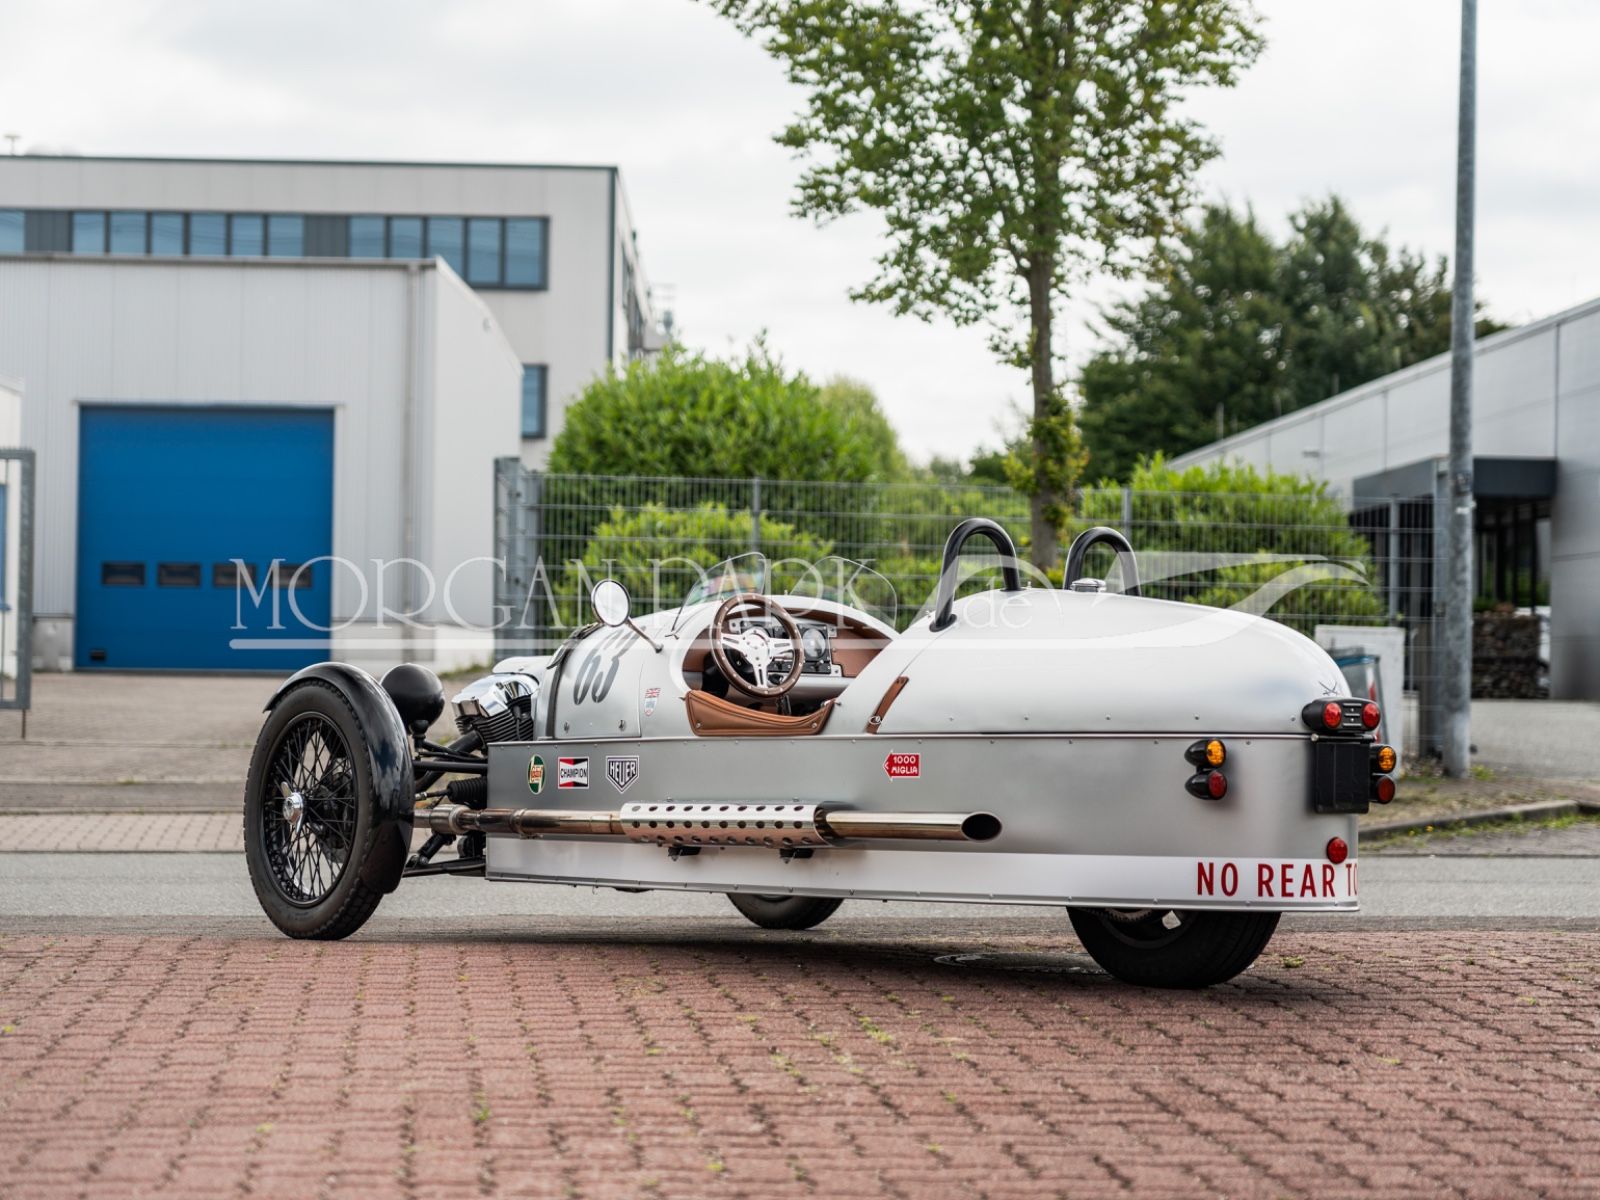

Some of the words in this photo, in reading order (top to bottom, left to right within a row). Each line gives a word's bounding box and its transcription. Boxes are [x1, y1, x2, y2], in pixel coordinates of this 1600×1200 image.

[893, 755, 916, 764] 1000
[560, 768, 587, 778] CHAMPION
[609, 760, 636, 786] HEUER
[1197, 862, 1239, 896] NO
[1257, 863, 1336, 897] REAR
